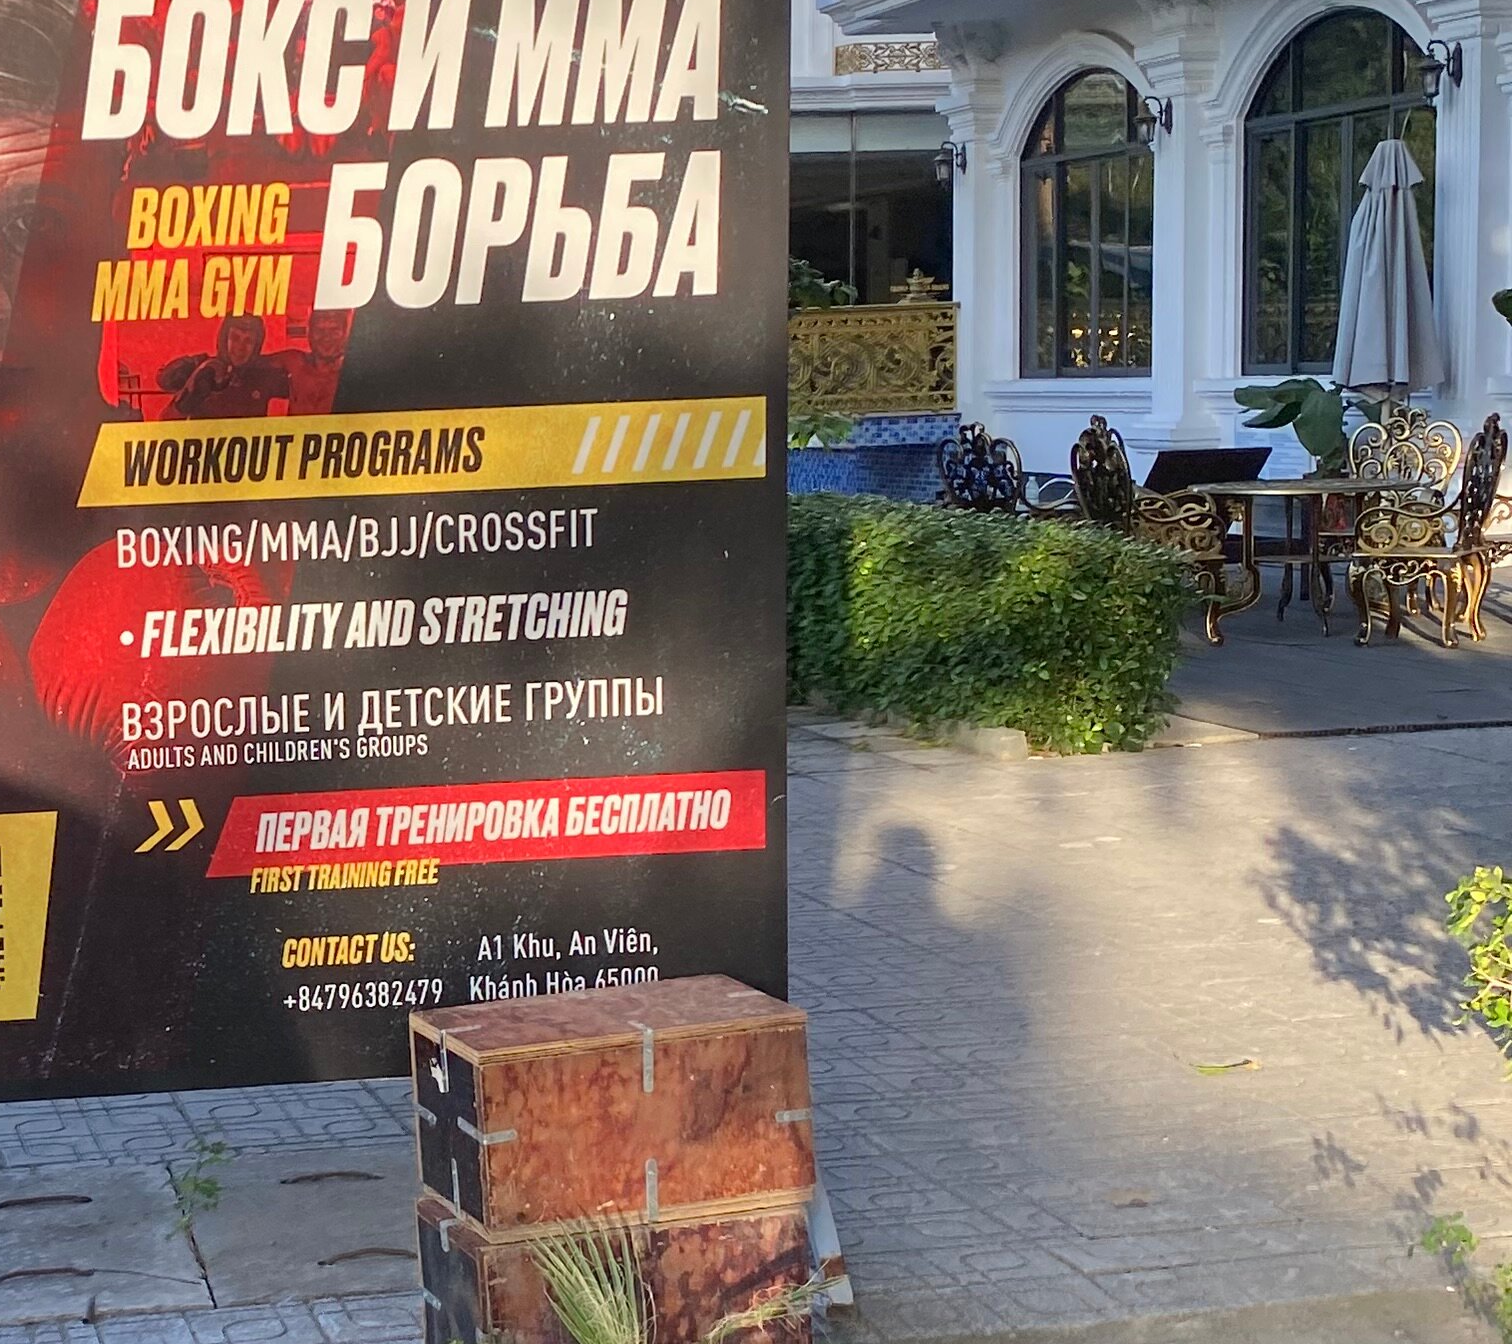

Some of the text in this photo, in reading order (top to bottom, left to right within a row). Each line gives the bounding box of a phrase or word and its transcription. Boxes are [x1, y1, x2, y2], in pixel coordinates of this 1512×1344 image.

[126, 183, 289, 250] BOXING
[313, 150, 721, 311] БОРЬБА
[91, 255, 292, 322] MMA GYM
[123, 427, 485, 488] WORKOUT PROGRAMS
[116, 508, 599, 570] BOXING/MMA/BJJ/CROSSFIT
[140, 589, 628, 658] FLEXIBILITY AND STRETCHING
[121, 676, 664, 742] ВЗРОСЛЫЕ И ДЕТСКИЕ ГРУППЫ
[128, 734, 428, 770] ADULTS AND CHILDREN'S GROUPS
[255, 789, 731, 853] ПЕРВАЯ ТРЕНИРОВКА БЕСПЛАТНО
[250, 858, 440, 894] FIRST TRAINING FREE
[282, 931, 416, 968] CONTACT US:
[478, 927, 658, 961] A1 Khu, An Viên,
[283, 978, 443, 1012] +84796382479
[469, 973, 537, 1001] Khánh
